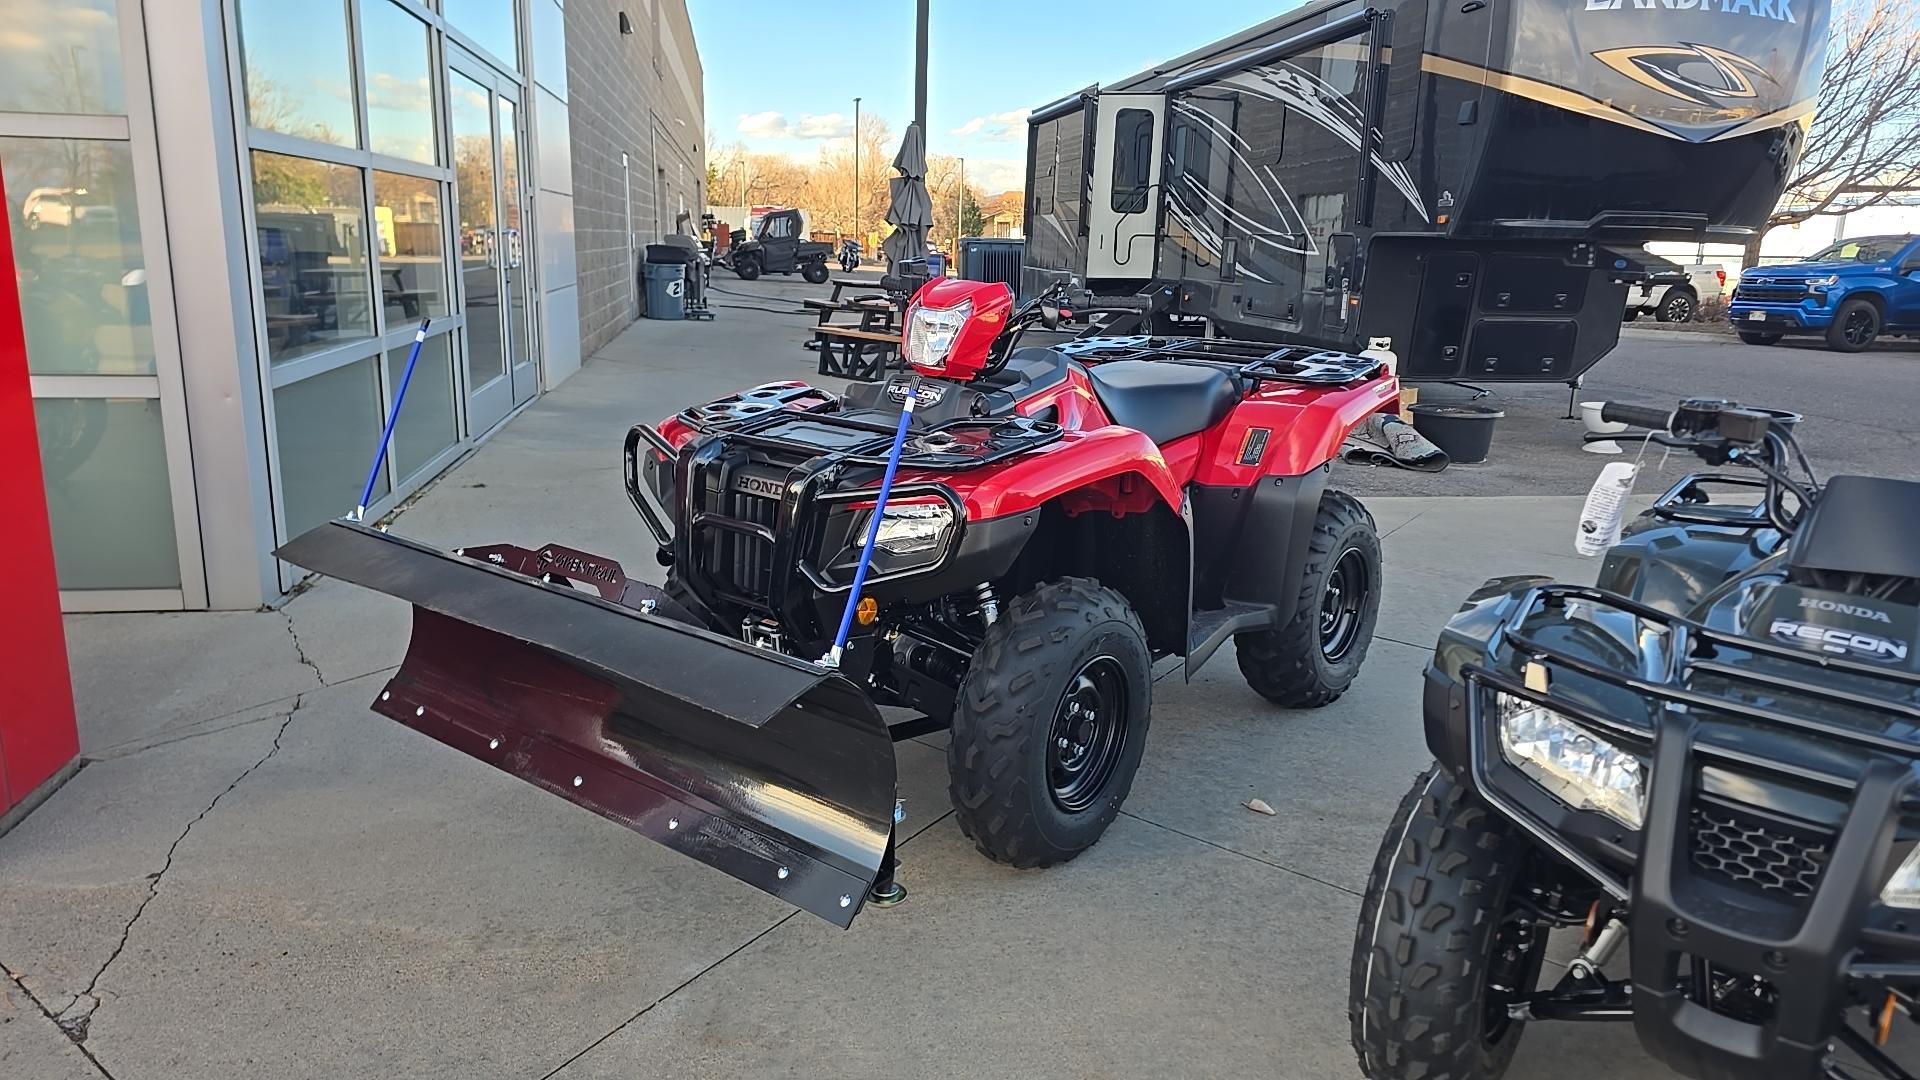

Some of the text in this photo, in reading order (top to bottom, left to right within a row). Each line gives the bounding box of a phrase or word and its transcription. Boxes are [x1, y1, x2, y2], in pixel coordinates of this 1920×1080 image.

[887, 385, 942, 401] RUBCON
[738, 475, 784, 496] HOND
[1798, 597, 1892, 623] HONDA
[1770, 621, 1908, 659] RECON
